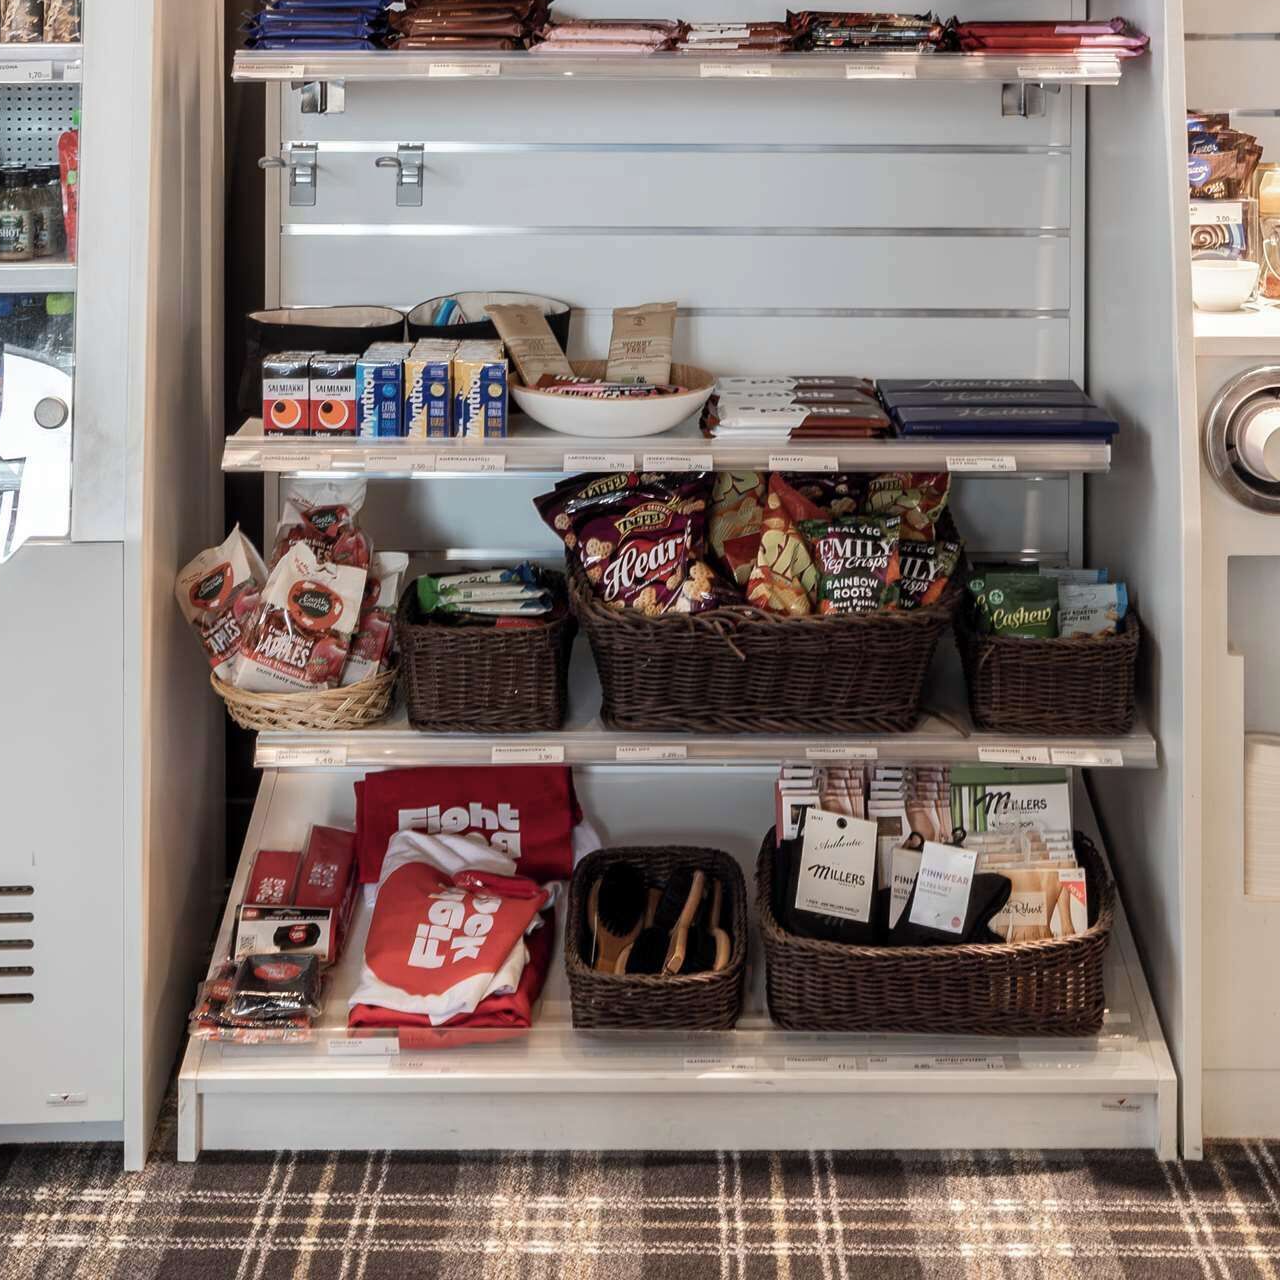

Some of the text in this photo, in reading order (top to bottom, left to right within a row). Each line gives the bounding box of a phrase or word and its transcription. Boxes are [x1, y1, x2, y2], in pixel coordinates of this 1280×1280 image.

[0, 227, 20, 238] SHOT
[268, 384, 304, 392] SALMIAKKI
[316, 384, 352, 393] SALMIAKKI
[621, 512, 665, 529] TAFFEL
[860, 525, 881, 536] VEG
[819, 538, 899, 559] EMILY
[823, 555, 888, 574] Veg Crisps
[826, 576, 878, 590] RAINBOW
[304, 593, 326, 606] Earth
[834, 588, 872, 599] ROOTS
[990, 606, 1051, 630] Cashew
[975, 791, 1048, 815] MILLERS
[808, 863, 866, 887] MILLERS
[921, 868, 970, 886] FINNWEAR
